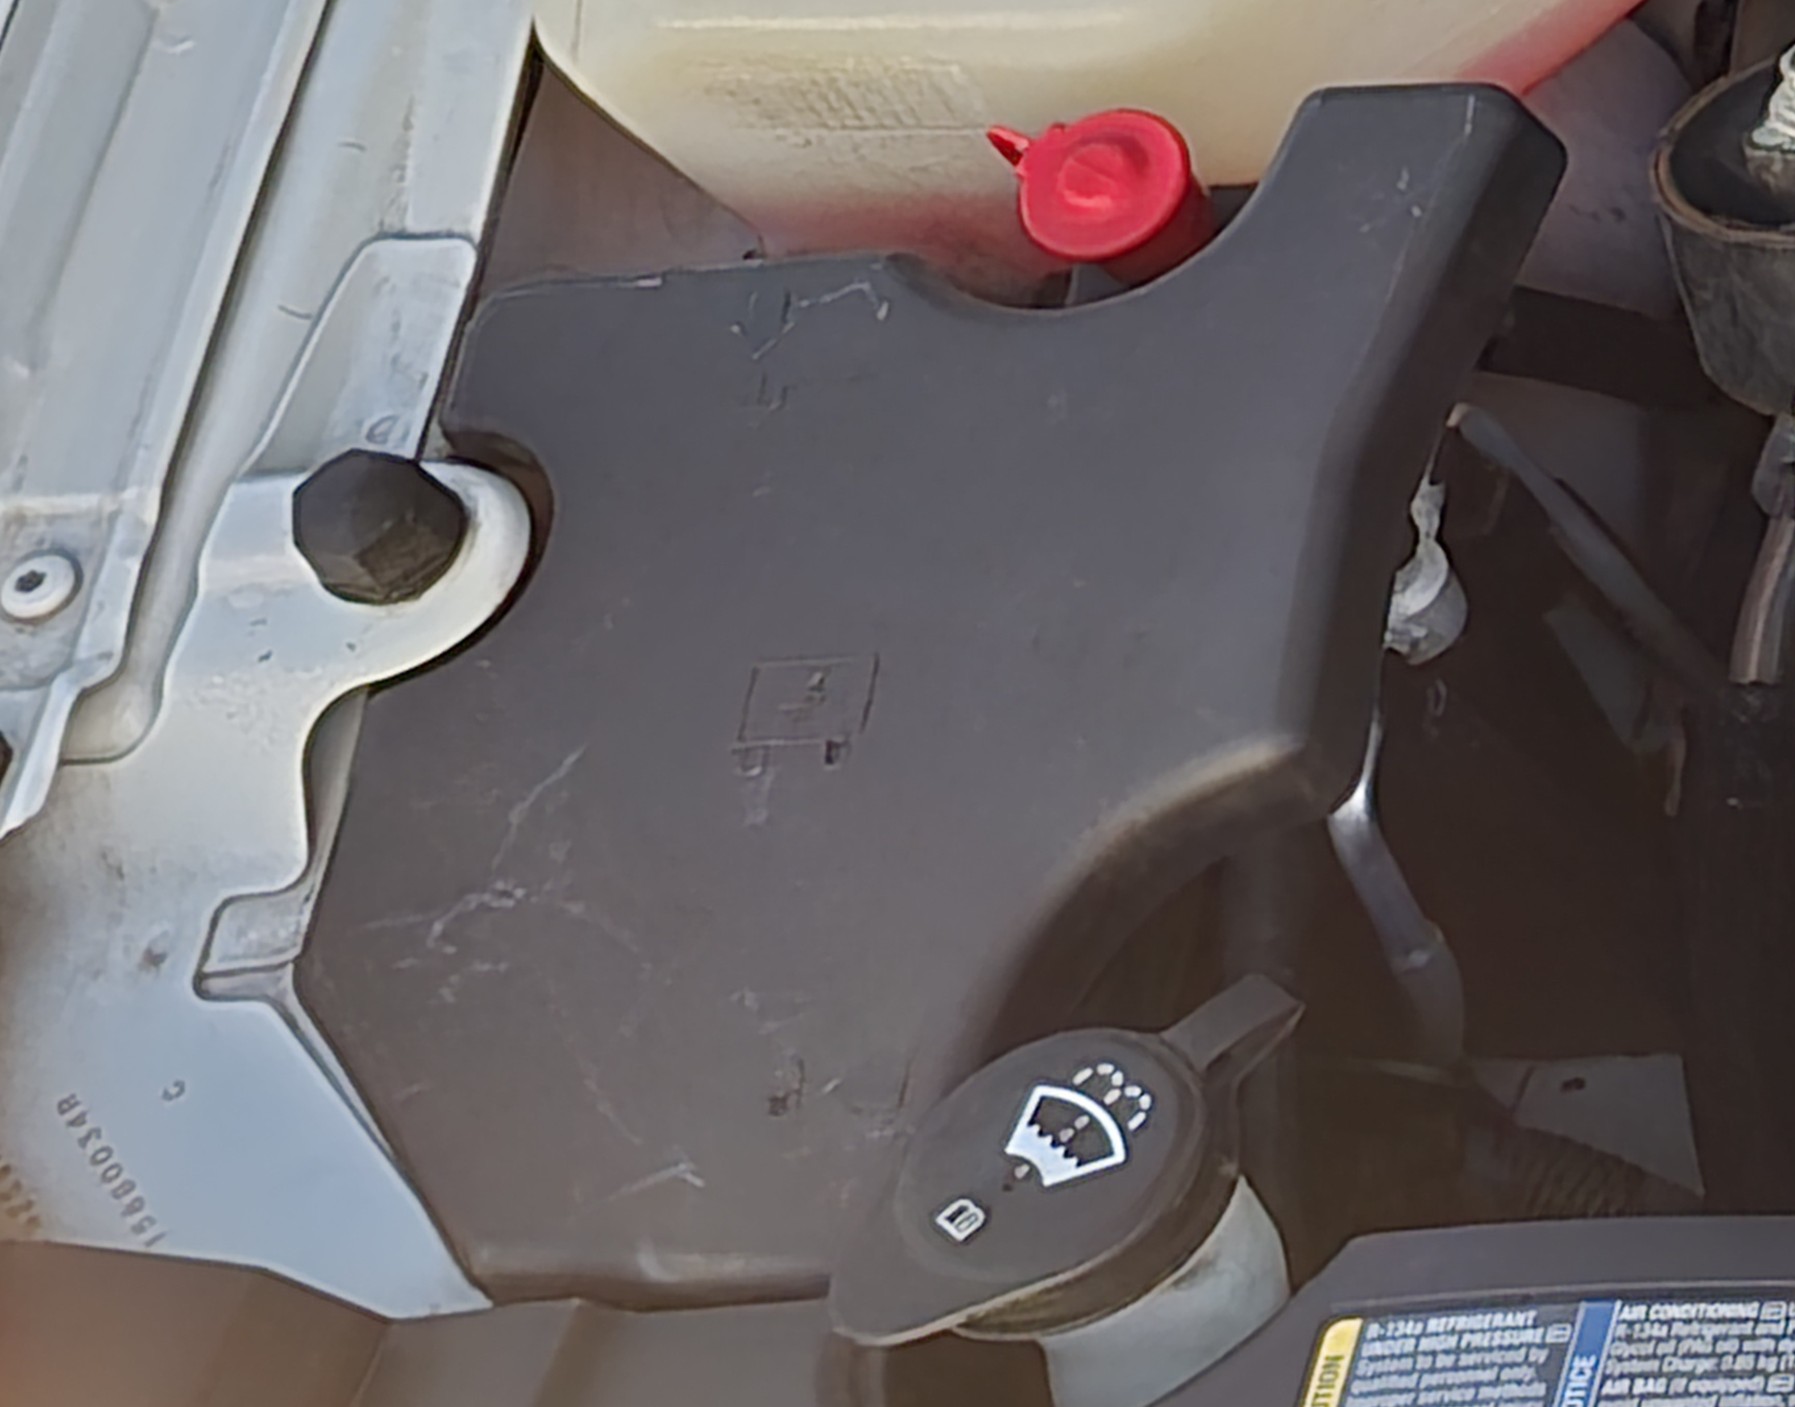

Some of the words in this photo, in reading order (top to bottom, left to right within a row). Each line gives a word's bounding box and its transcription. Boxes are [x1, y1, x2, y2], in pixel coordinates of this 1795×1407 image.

[1619, 1303, 1649, 1322] AIR
[1649, 1301, 1760, 1321] CONDITIONING
[1311, 1354, 1345, 1407] TION
[1562, 1354, 1597, 1407] OTICE
